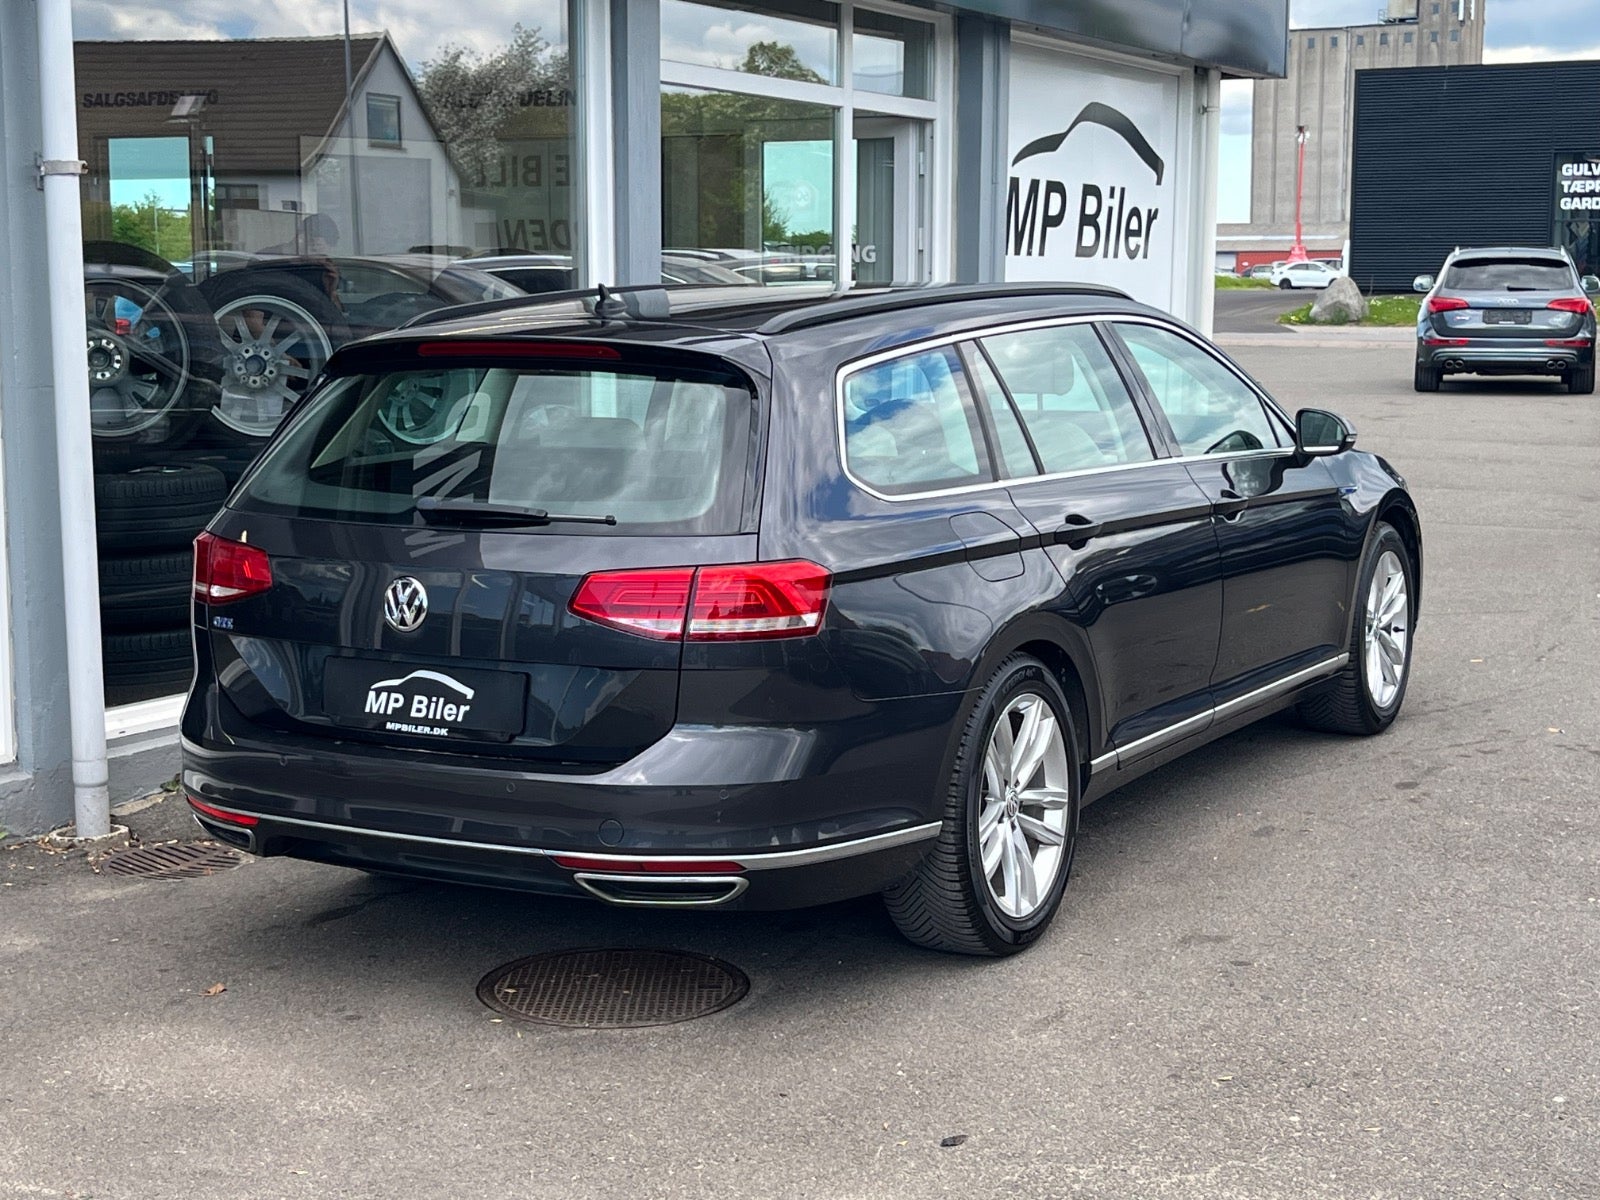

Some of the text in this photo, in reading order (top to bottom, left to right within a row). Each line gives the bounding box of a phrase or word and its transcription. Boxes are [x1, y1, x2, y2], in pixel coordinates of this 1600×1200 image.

[1560, 197, 1600, 210] GARD
[1005, 176, 1159, 260] MP Biler
[364, 690, 471, 722] MP Biler
[385, 721, 449, 736] MPBILER.DK
